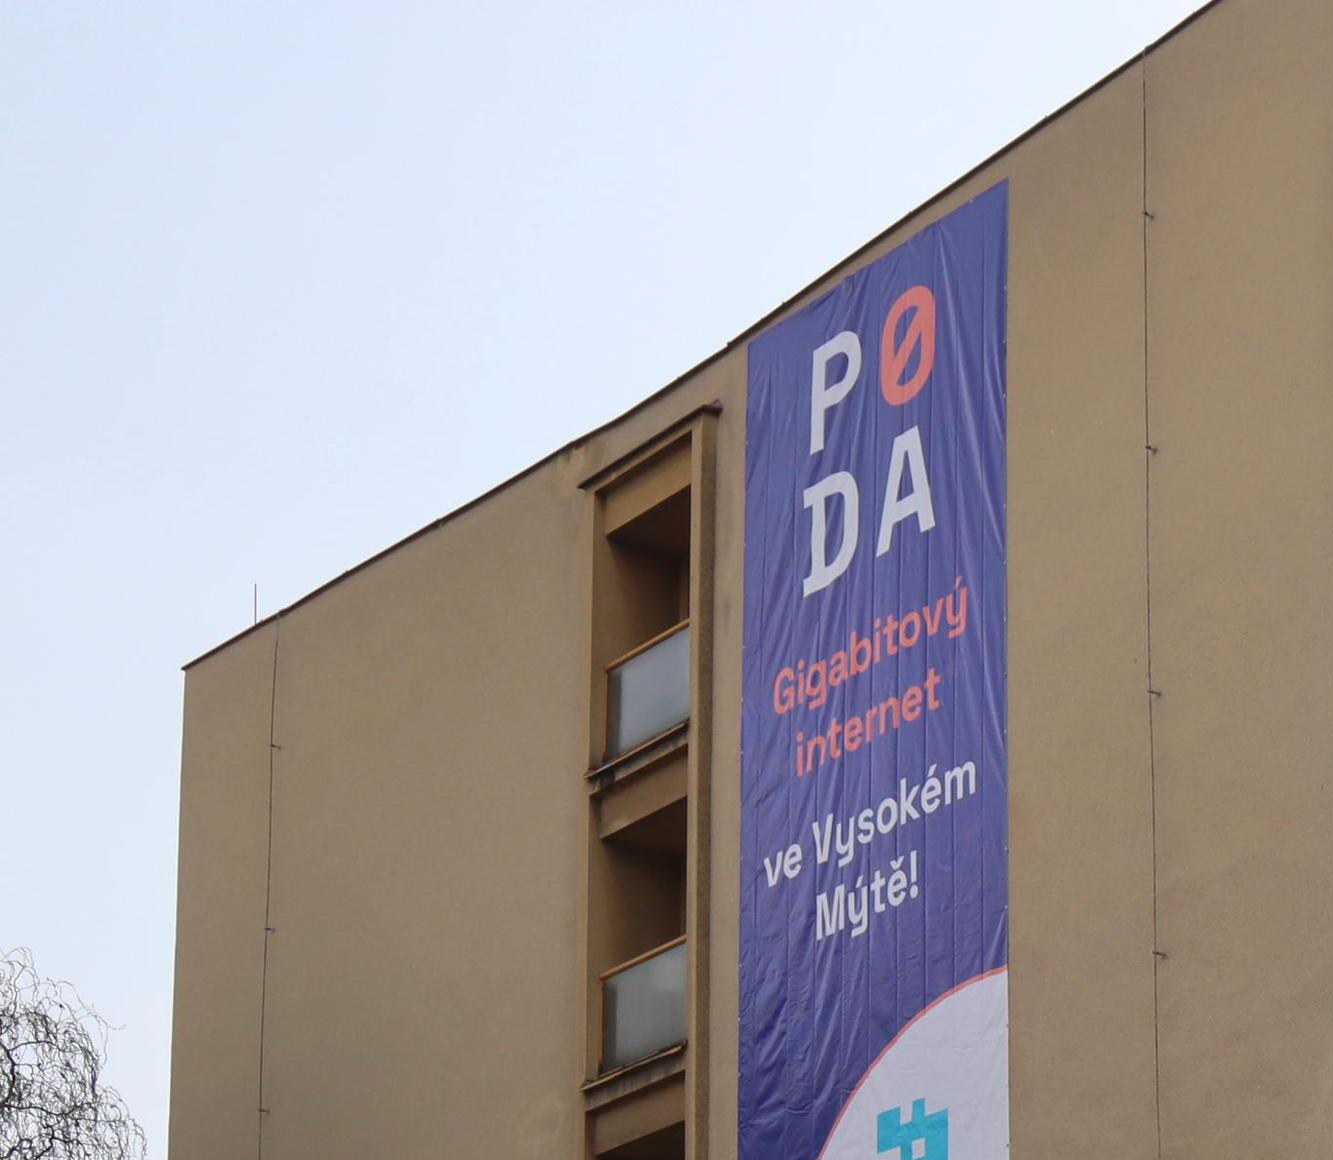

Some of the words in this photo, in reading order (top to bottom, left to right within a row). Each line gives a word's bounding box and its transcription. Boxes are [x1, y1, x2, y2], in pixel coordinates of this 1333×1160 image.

[773, 575, 968, 715] Gigabitový
[796, 667, 941, 778] internet
[764, 843, 803, 888] ve
[812, 760, 976, 868] Vysokém
[815, 849, 919, 941] Mýtě!
